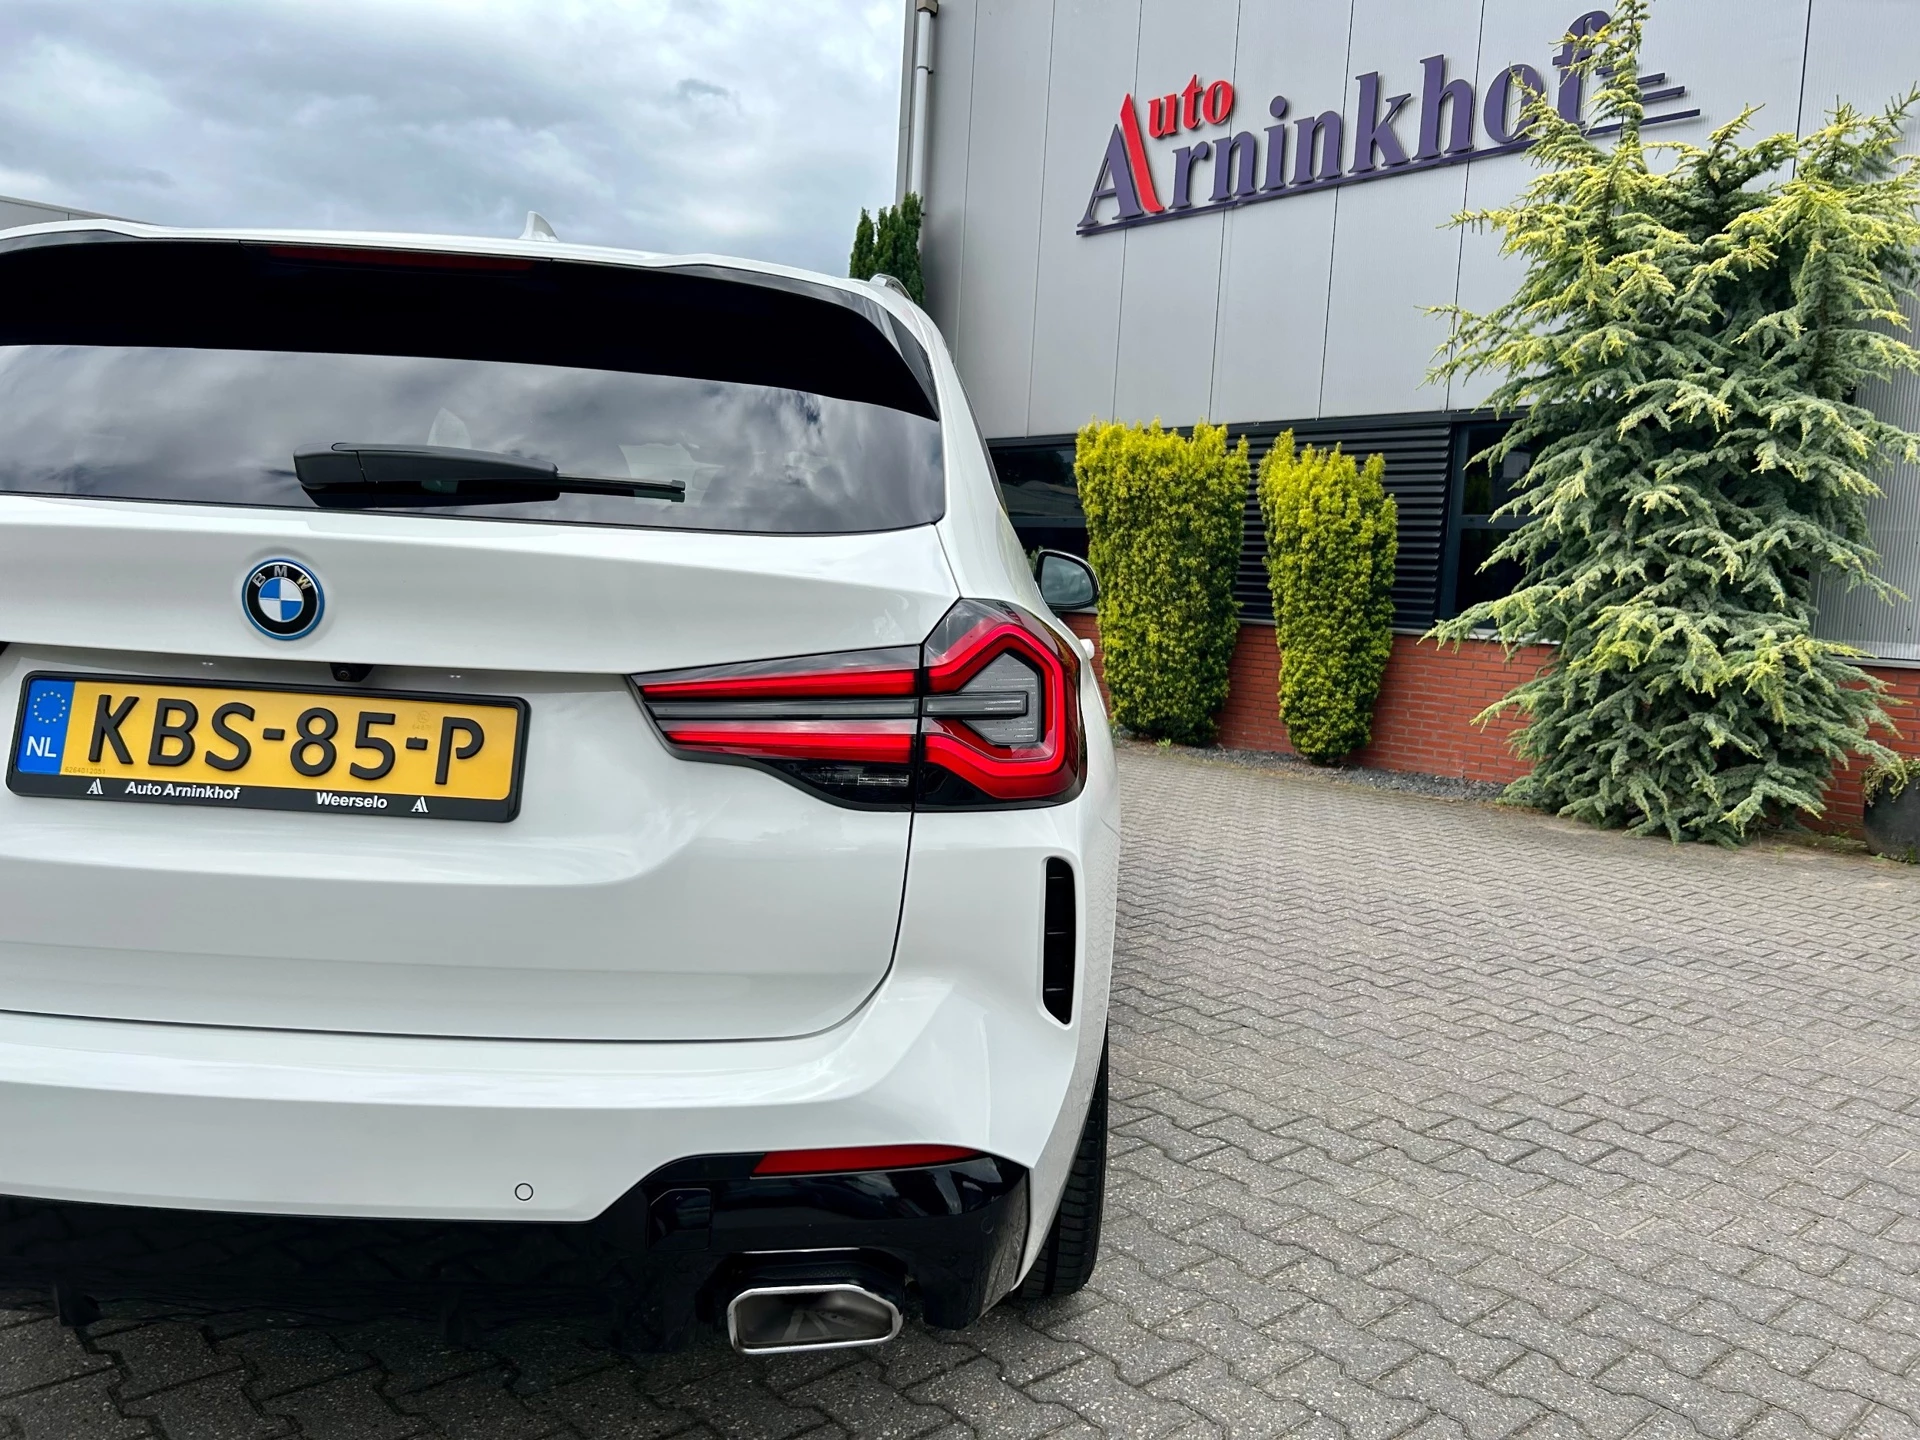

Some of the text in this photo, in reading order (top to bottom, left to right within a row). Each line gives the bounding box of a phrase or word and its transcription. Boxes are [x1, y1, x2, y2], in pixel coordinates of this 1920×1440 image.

[1077, 10, 1611, 227] Arninkhof
[252, 565, 312, 590] BMW
[26, 735, 57, 757] NL
[88, 694, 485, 786] KBS-85-P
[125, 781, 241, 800] Auto Arninkhof
[316, 791, 388, 809] Weerselo
